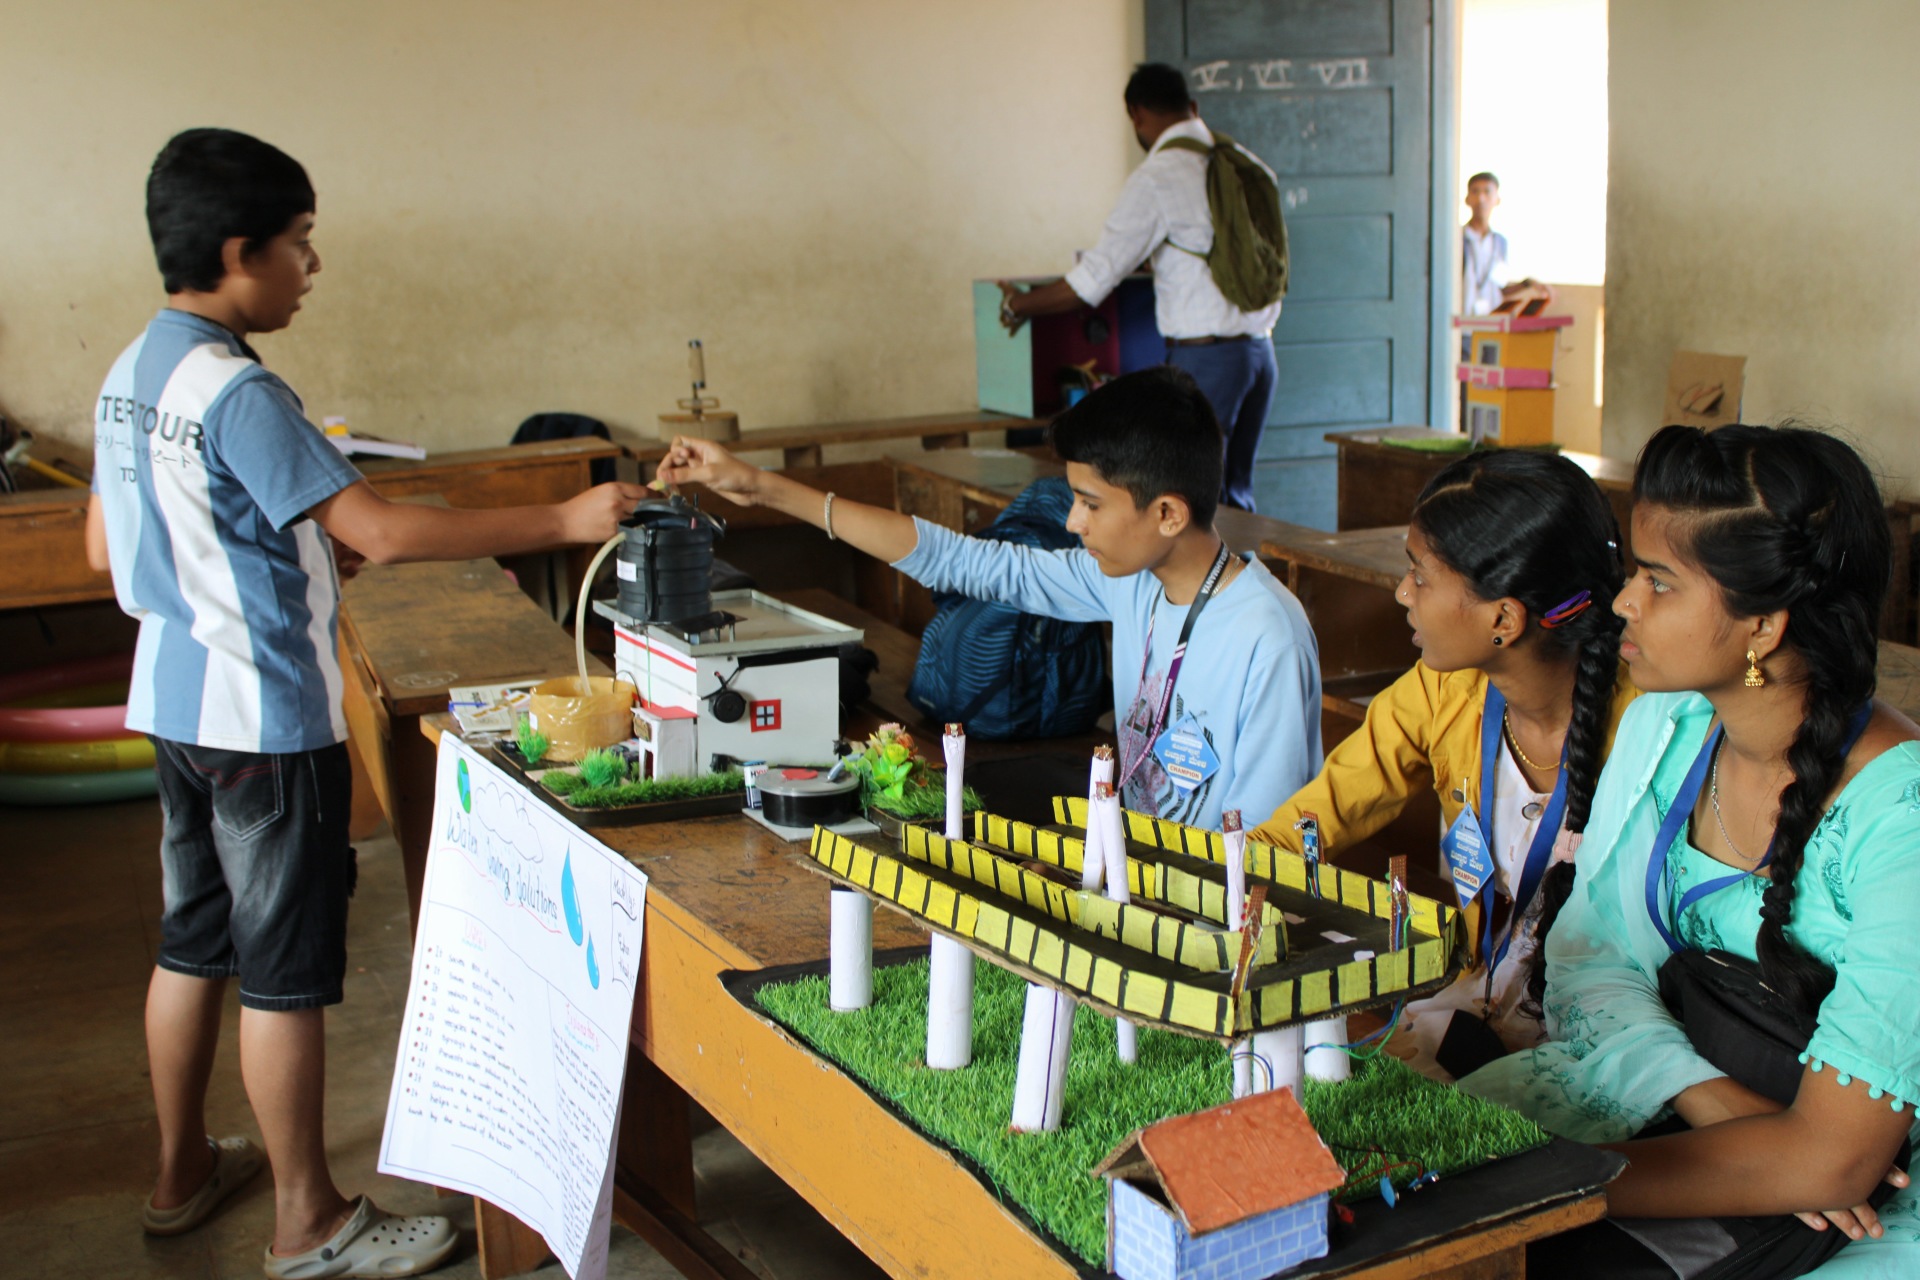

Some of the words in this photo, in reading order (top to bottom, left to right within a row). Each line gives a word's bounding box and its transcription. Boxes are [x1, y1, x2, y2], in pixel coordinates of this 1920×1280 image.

[1310, 58, 1370, 87] VII
[1169, 764, 1200, 779] CHAMPION
[1454, 868, 1479, 886] CHAMPION
